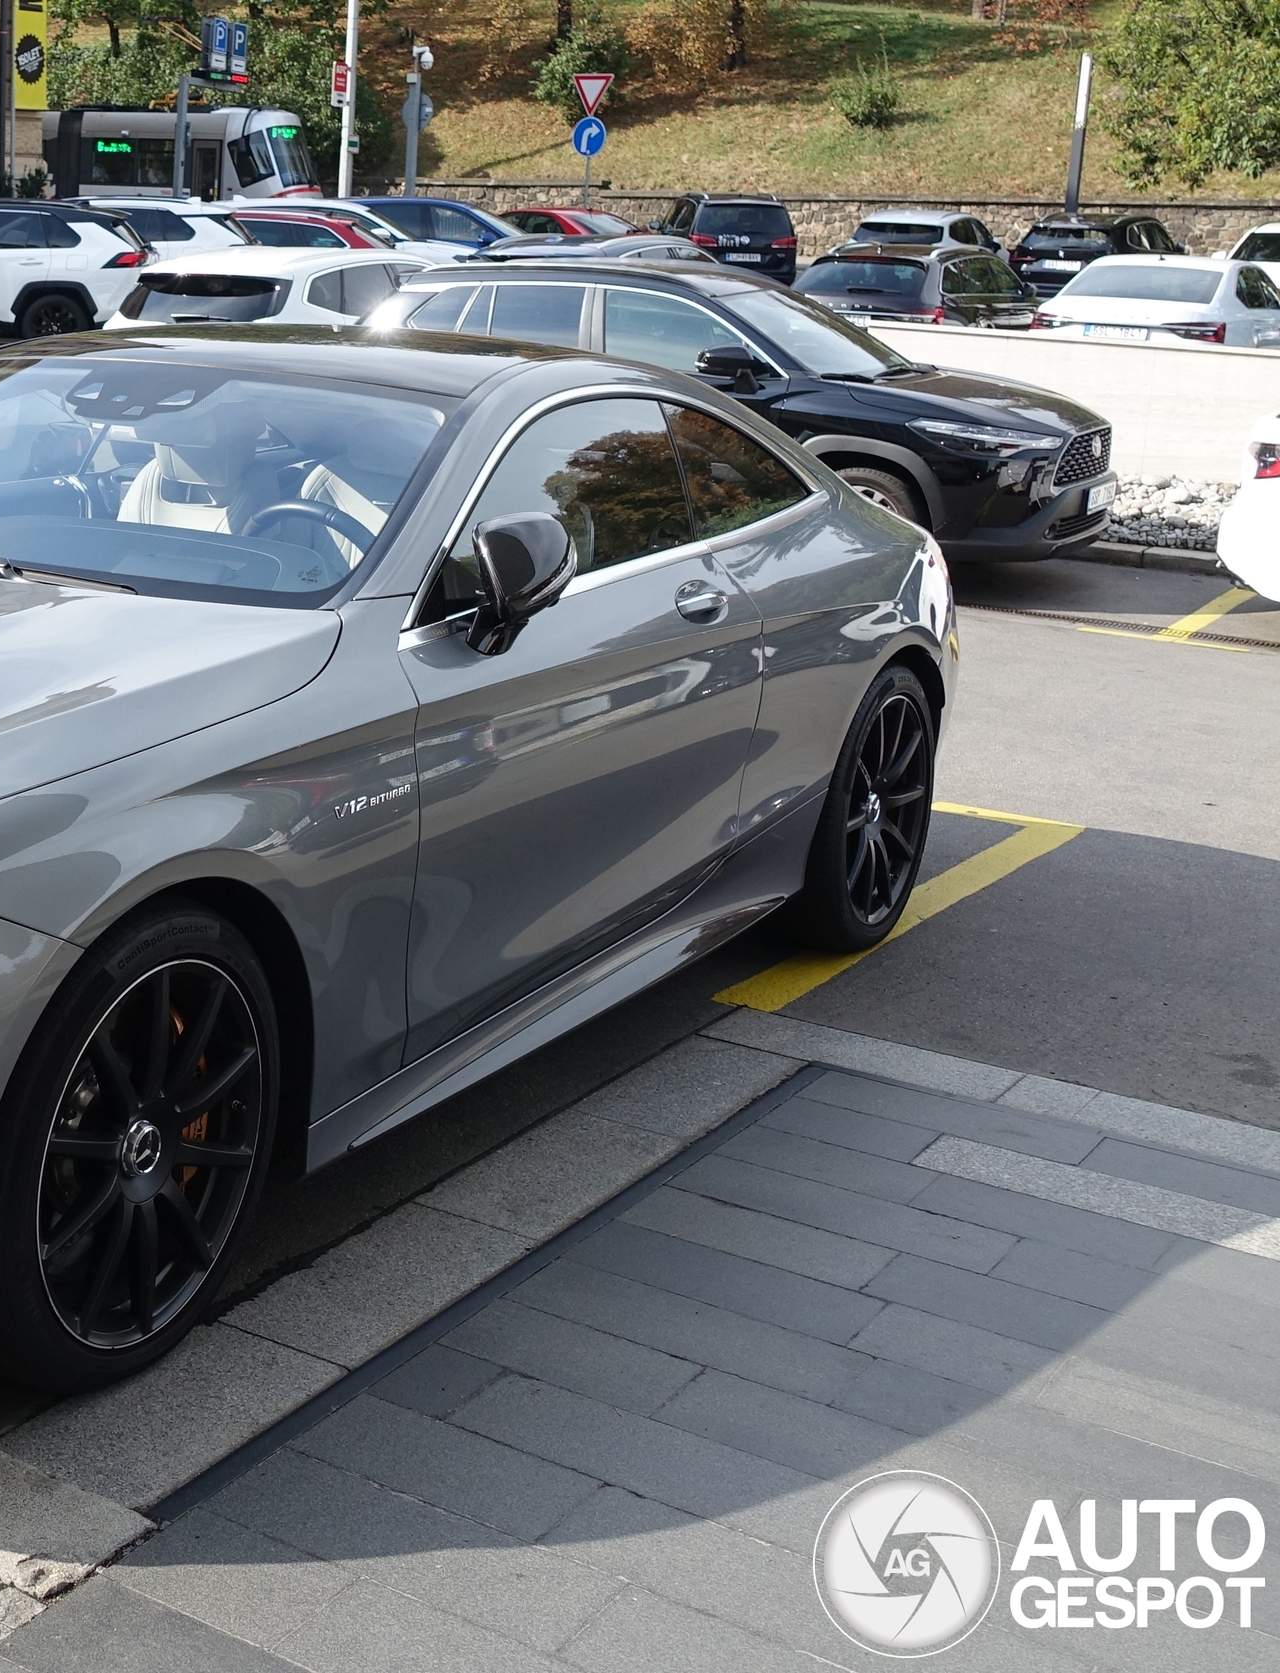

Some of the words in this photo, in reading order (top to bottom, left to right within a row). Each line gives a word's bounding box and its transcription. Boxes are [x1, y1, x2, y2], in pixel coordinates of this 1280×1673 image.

[234, 30, 245, 50] P
[334, 795, 369, 820] V12
[370, 784, 411, 807] BITURBO
